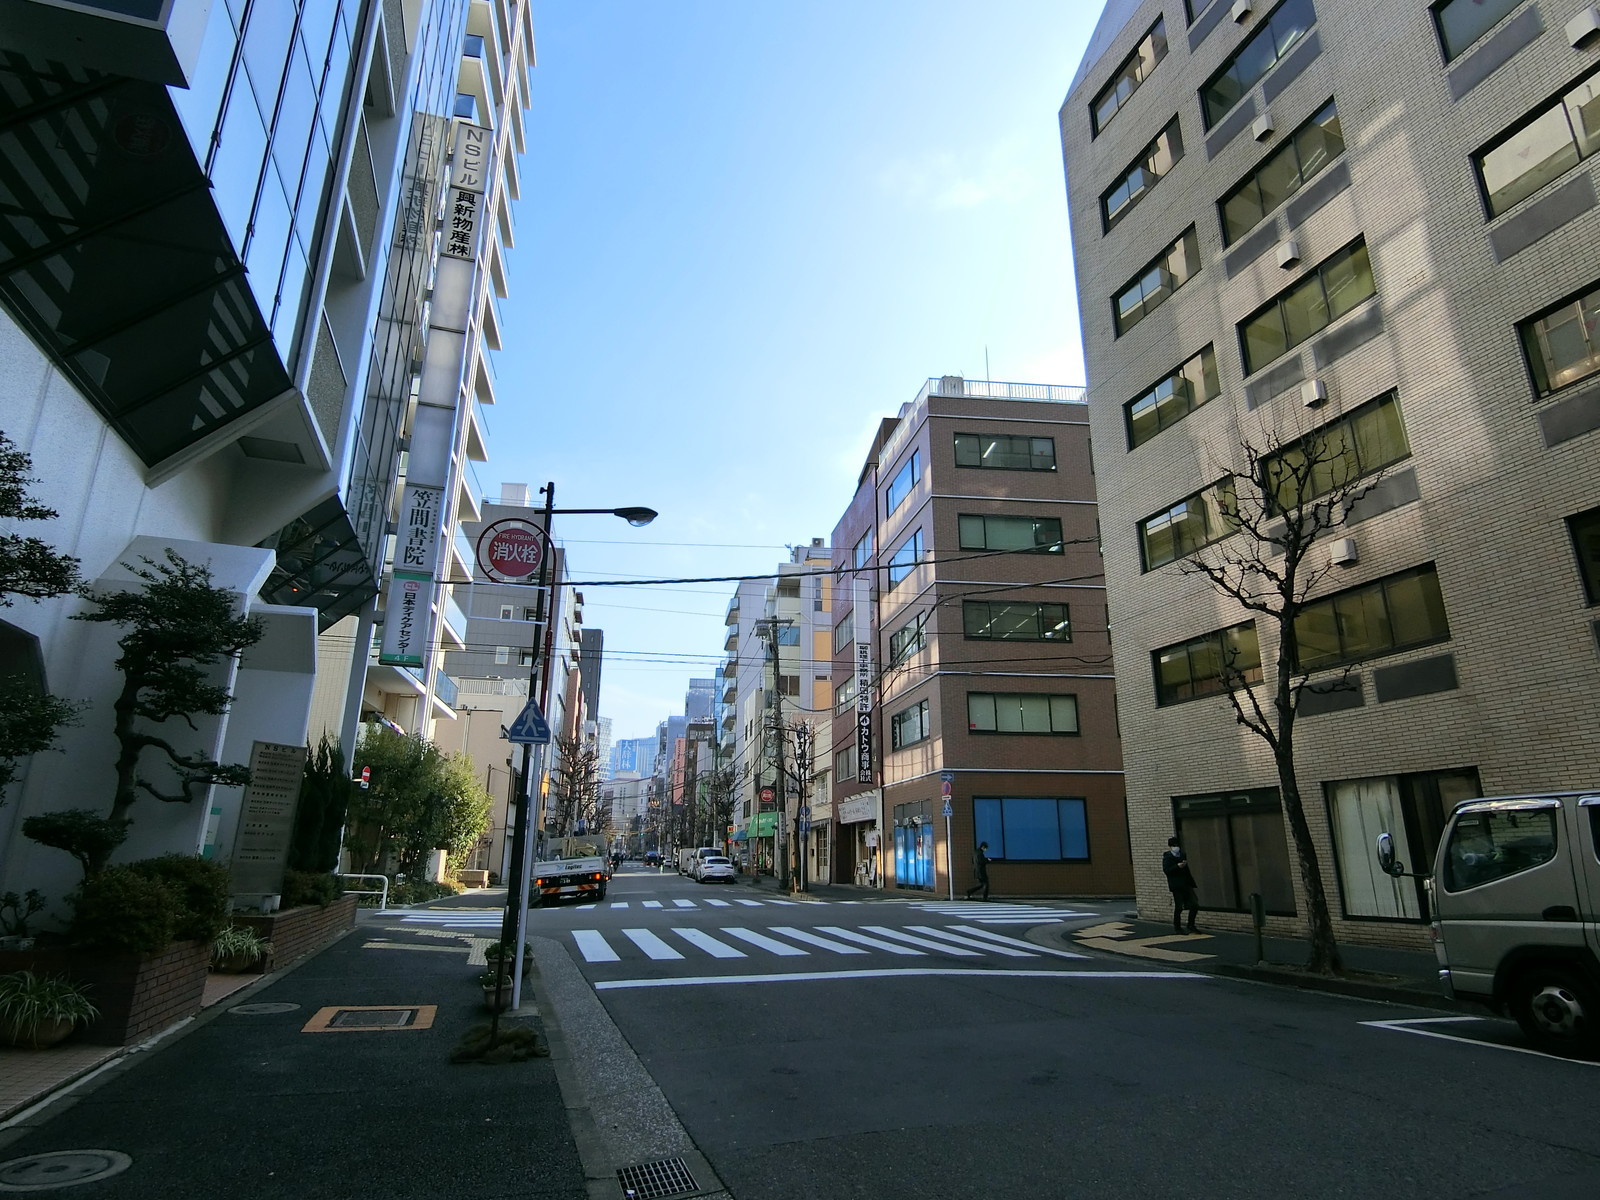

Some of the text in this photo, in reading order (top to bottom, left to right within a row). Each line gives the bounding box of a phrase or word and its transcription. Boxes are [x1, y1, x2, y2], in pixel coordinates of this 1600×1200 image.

[460, 129, 483, 186] NSビル
[403, 488, 434, 566] 笠間書院
[511, 534, 535, 542] HYDRANT
[492, 541, 539, 564] 消火栓
